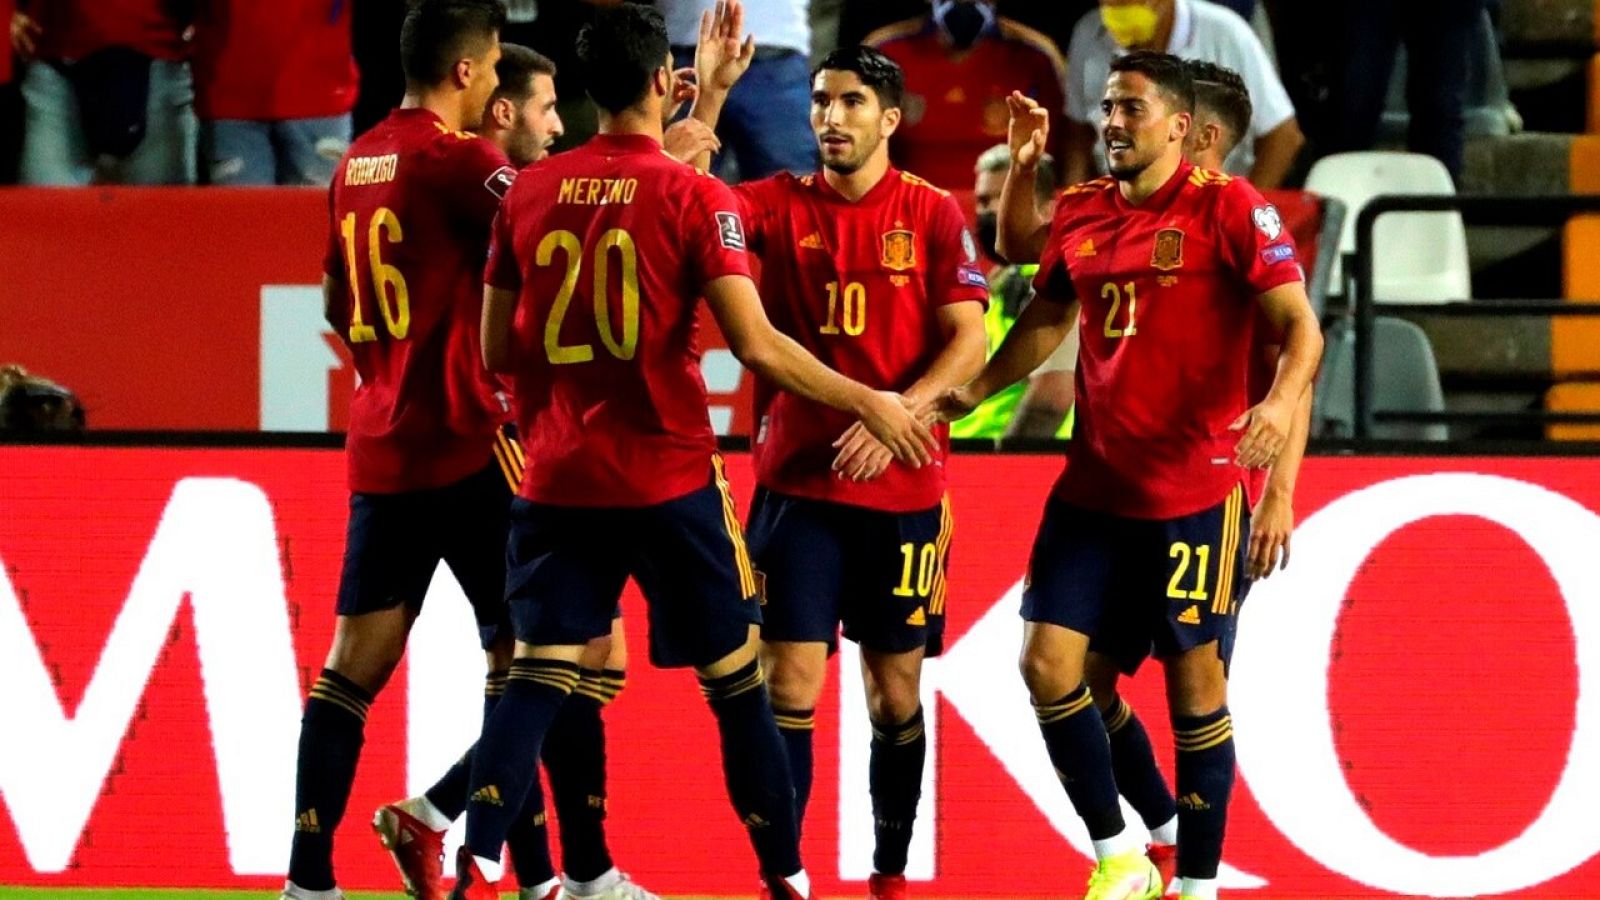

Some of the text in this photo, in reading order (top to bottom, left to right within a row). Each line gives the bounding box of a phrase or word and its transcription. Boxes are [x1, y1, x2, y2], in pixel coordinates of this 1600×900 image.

[344, 153, 399, 186] RODRIGO
[557, 177, 638, 205] MERINO
[340, 207, 411, 343] 16
[535, 228, 640, 365] 20
[819, 281, 866, 336] 10
[1101, 281, 1137, 338] 21
[892, 542, 936, 597] 10
[1166, 541, 1210, 601] 21
